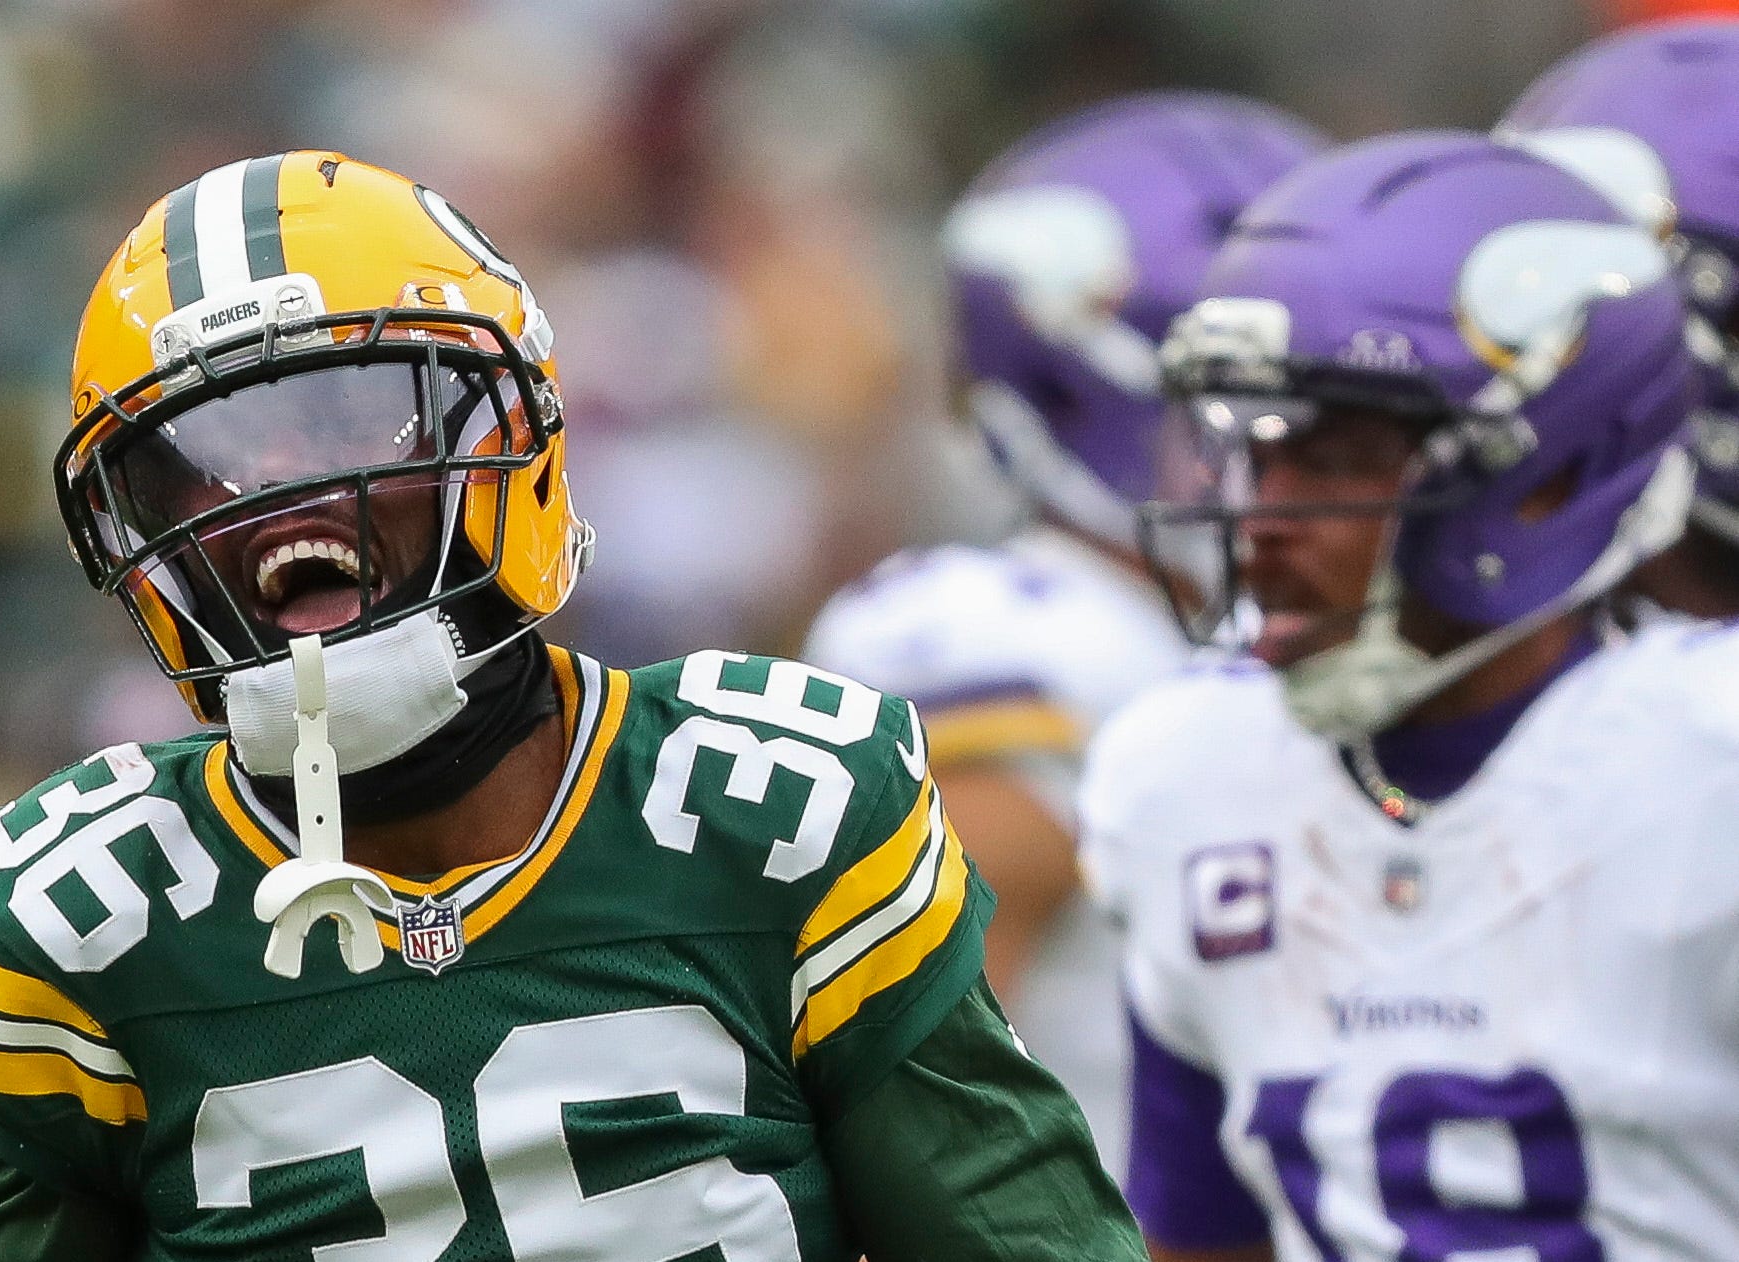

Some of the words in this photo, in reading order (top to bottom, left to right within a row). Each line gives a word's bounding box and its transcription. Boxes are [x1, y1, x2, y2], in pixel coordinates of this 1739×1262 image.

[200, 301, 261, 332] PACKERS
[641, 649, 883, 884] 36
[409, 929, 454, 961] NFL
